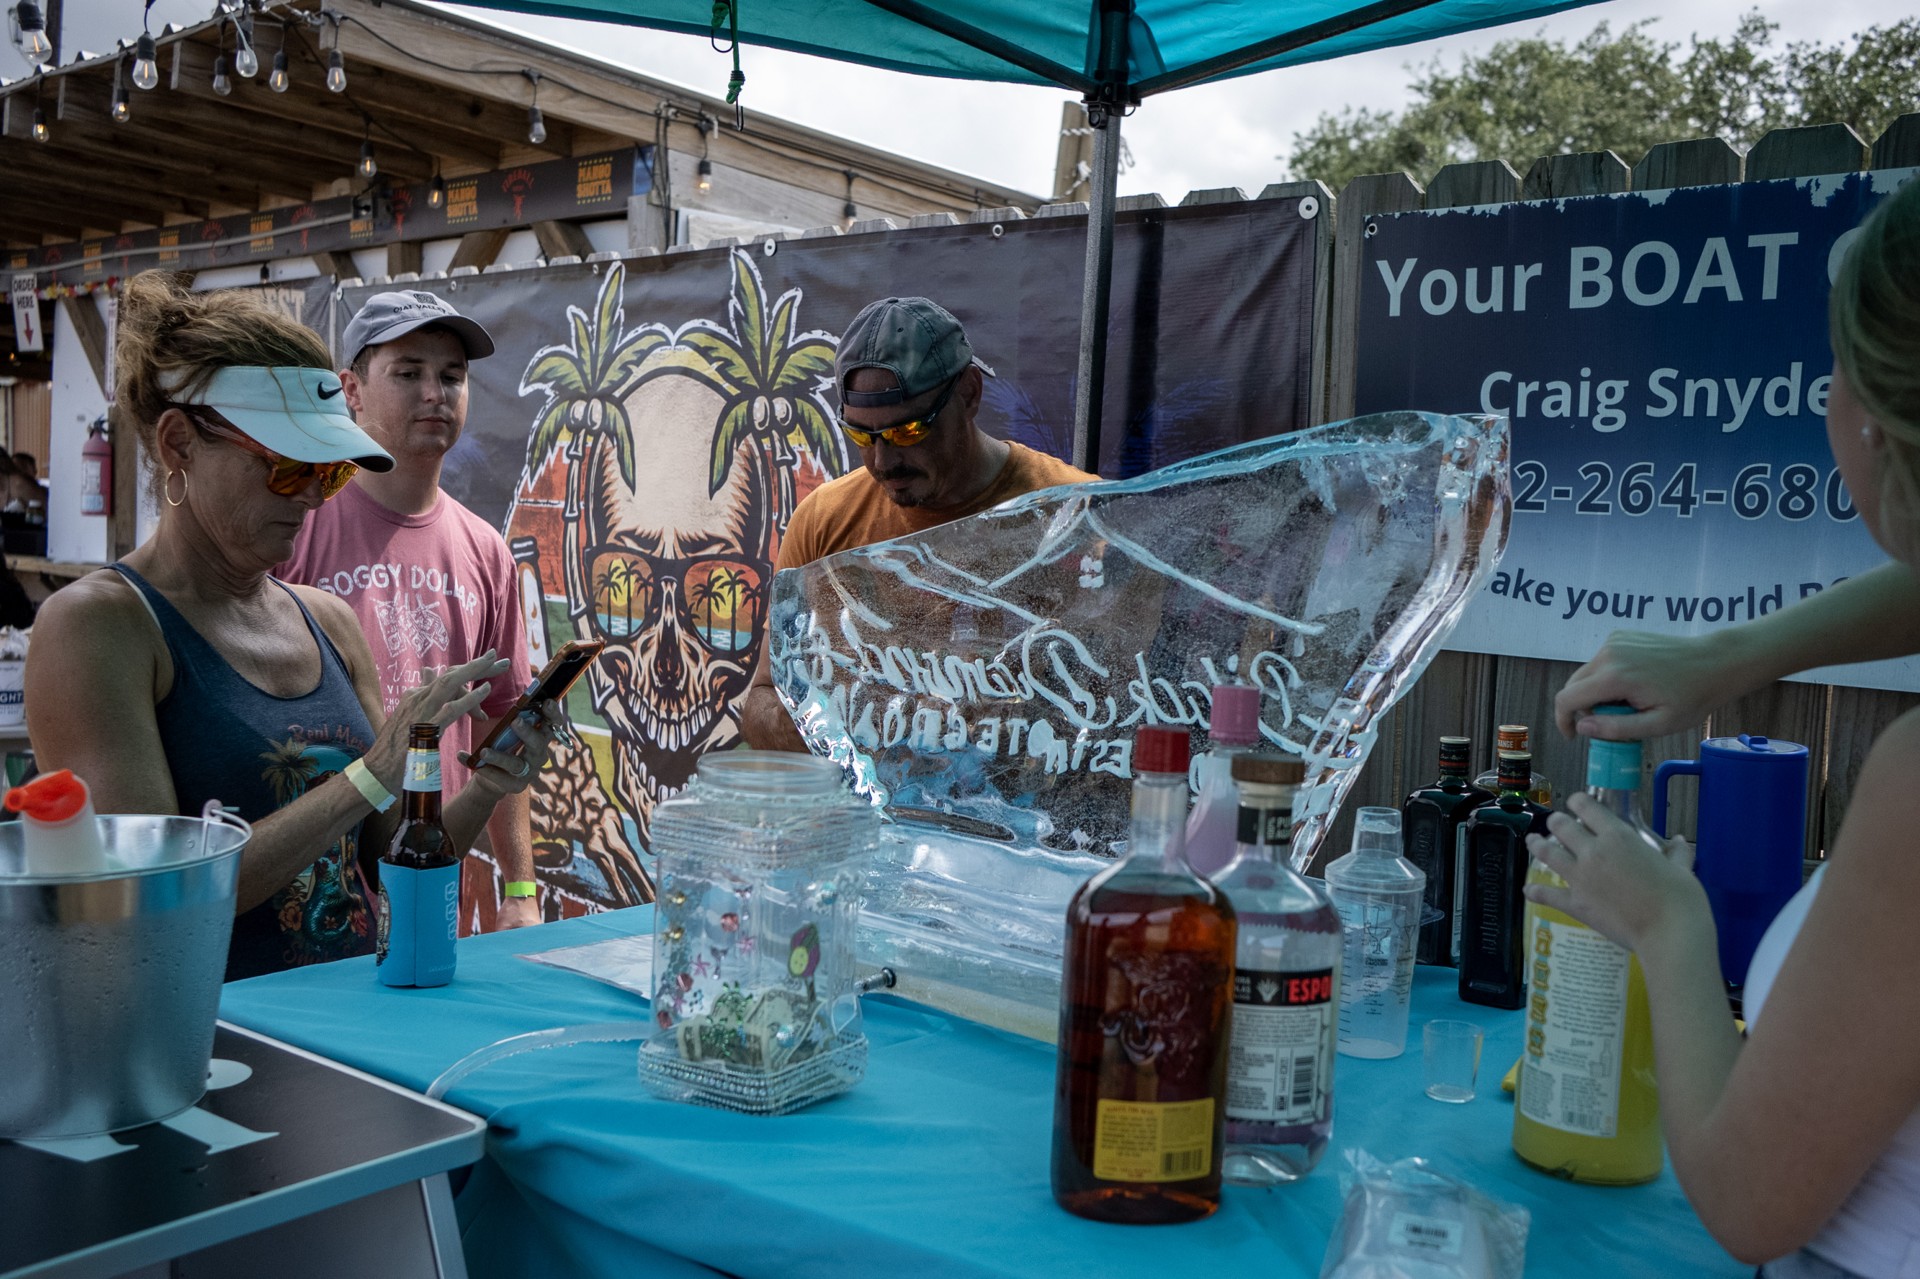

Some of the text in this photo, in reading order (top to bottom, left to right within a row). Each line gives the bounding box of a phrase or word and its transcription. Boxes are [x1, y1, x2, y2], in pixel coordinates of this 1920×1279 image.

[577, 163, 612, 183] MANGO
[447, 186, 478, 204] MANGO
[576, 179, 613, 199] SHOTTA
[447, 201, 478, 218] SHOTTA
[1376, 257, 1543, 318] Your
[1568, 231, 1800, 310] BOAT
[13, 278, 36, 292] ORDER
[17, 295, 34, 309] HERE
[1480, 367, 1630, 433] Craig
[317, 563, 478, 616] SOGGY DOLLAR
[1561, 586, 1655, 620] your
[1665, 583, 1783, 622] world
